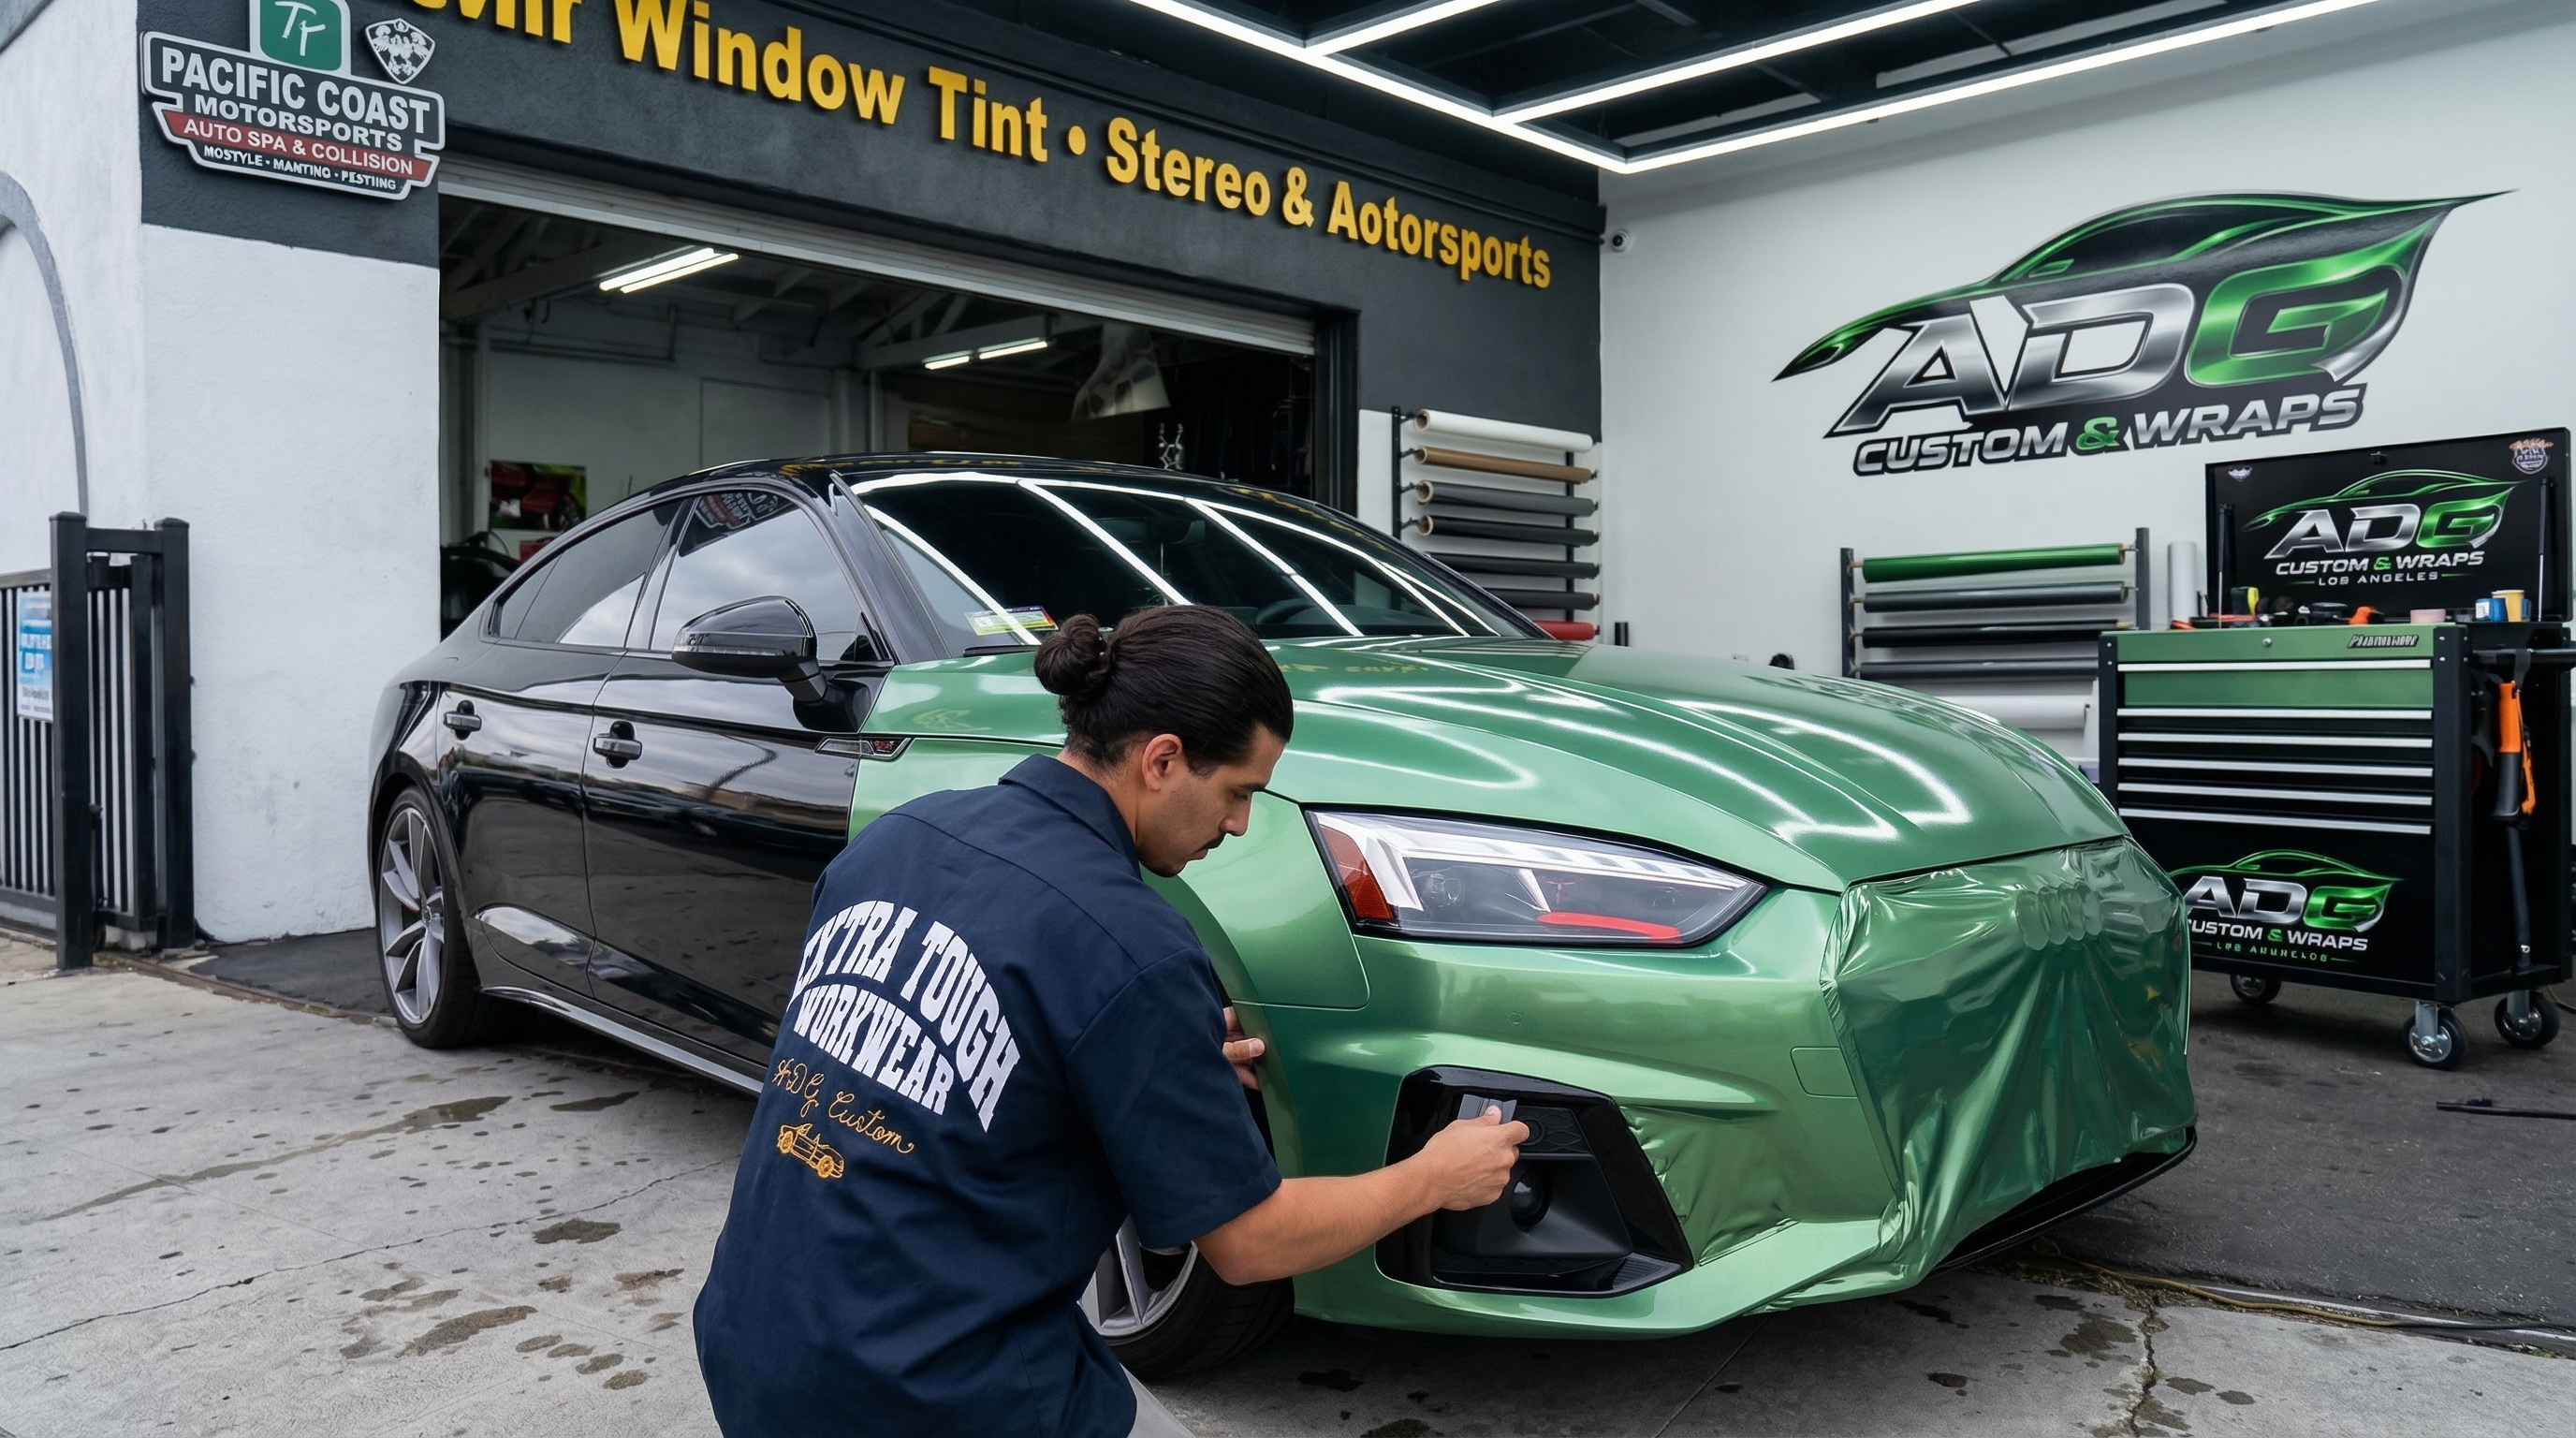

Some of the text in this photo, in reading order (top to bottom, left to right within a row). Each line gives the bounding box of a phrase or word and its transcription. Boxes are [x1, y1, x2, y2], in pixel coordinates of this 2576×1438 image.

[162, 46, 431, 134] PACIFIC COAST
[183, 119, 413, 176] AUTO SPA & COLLISION
[194, 94, 402, 153] MOTORSPORTS
[203, 145, 264, 167] MOSTYLE
[616, 0, 905, 125] Window
[929, 66, 1049, 163] Tint
[1106, 117, 1271, 216] Stereo
[1282, 167, 1315, 227] &
[1327, 181, 1551, 288] Aotorsports
[1825, 236, 2422, 434] ADG
[1855, 385, 2362, 476] CUSTOM & WRAPS
[2263, 490, 2510, 560] ADG
[2276, 550, 2485, 576] CUSTOM & WRAPS
[2184, 875, 2389, 932] ADG
[2287, 930, 2368, 951] WRAPS
[785, 900, 1021, 1133] EXTRA TOUGH
[794, 984, 955, 1115] WORKWEAR
[828, 1091, 915, 1153] Custom
